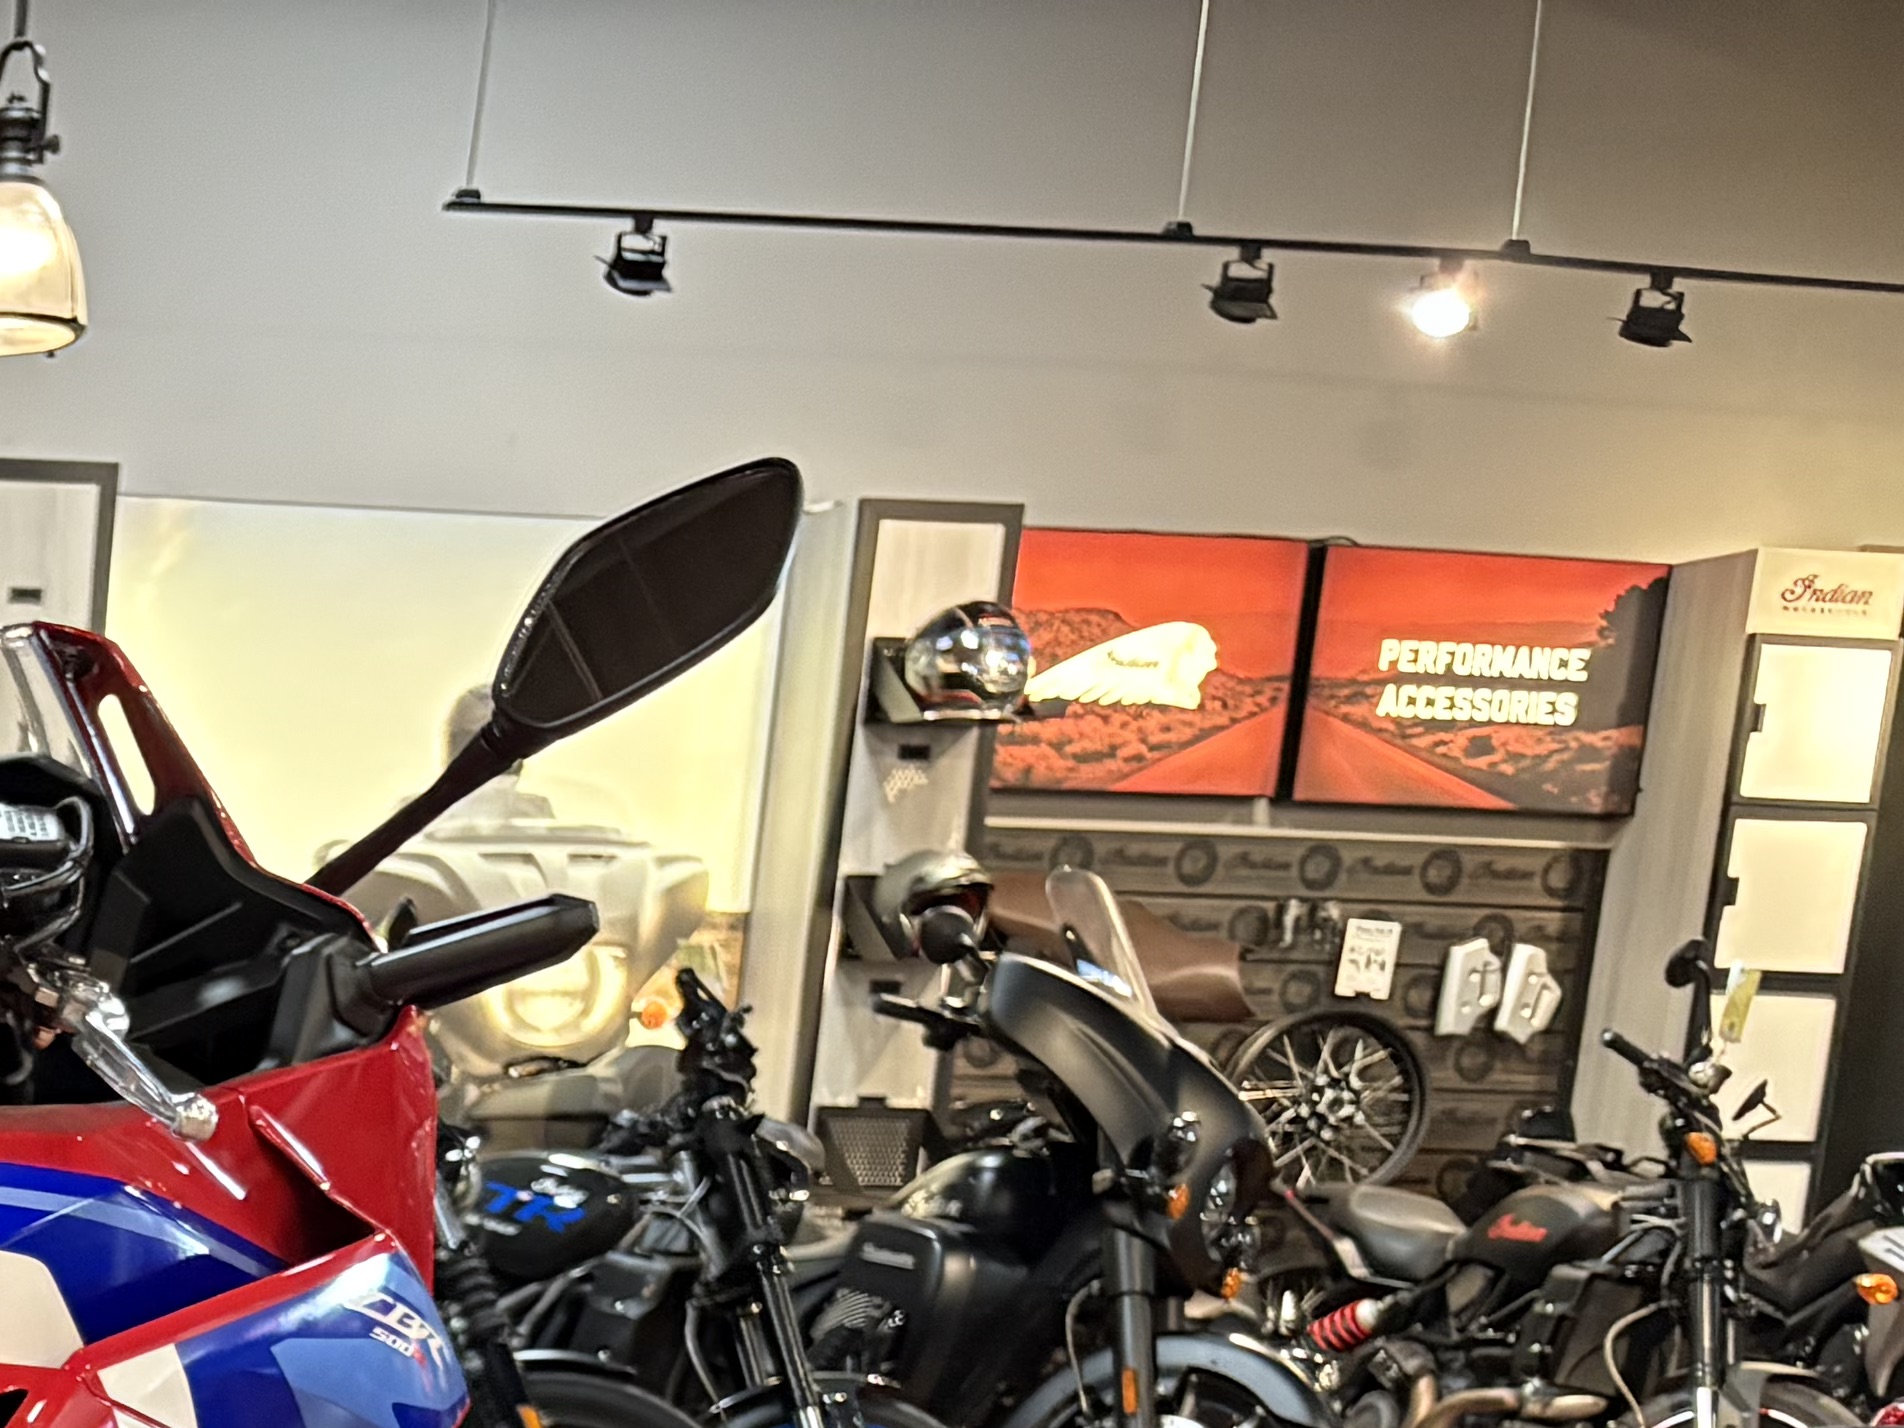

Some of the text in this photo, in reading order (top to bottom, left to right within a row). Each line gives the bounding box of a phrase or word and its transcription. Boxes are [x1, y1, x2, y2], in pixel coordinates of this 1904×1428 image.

[1781, 574, 1873, 606] Indian
[1378, 638, 1591, 682] PERFORMANCE
[1376, 683, 1579, 726] ACCESSORIES
